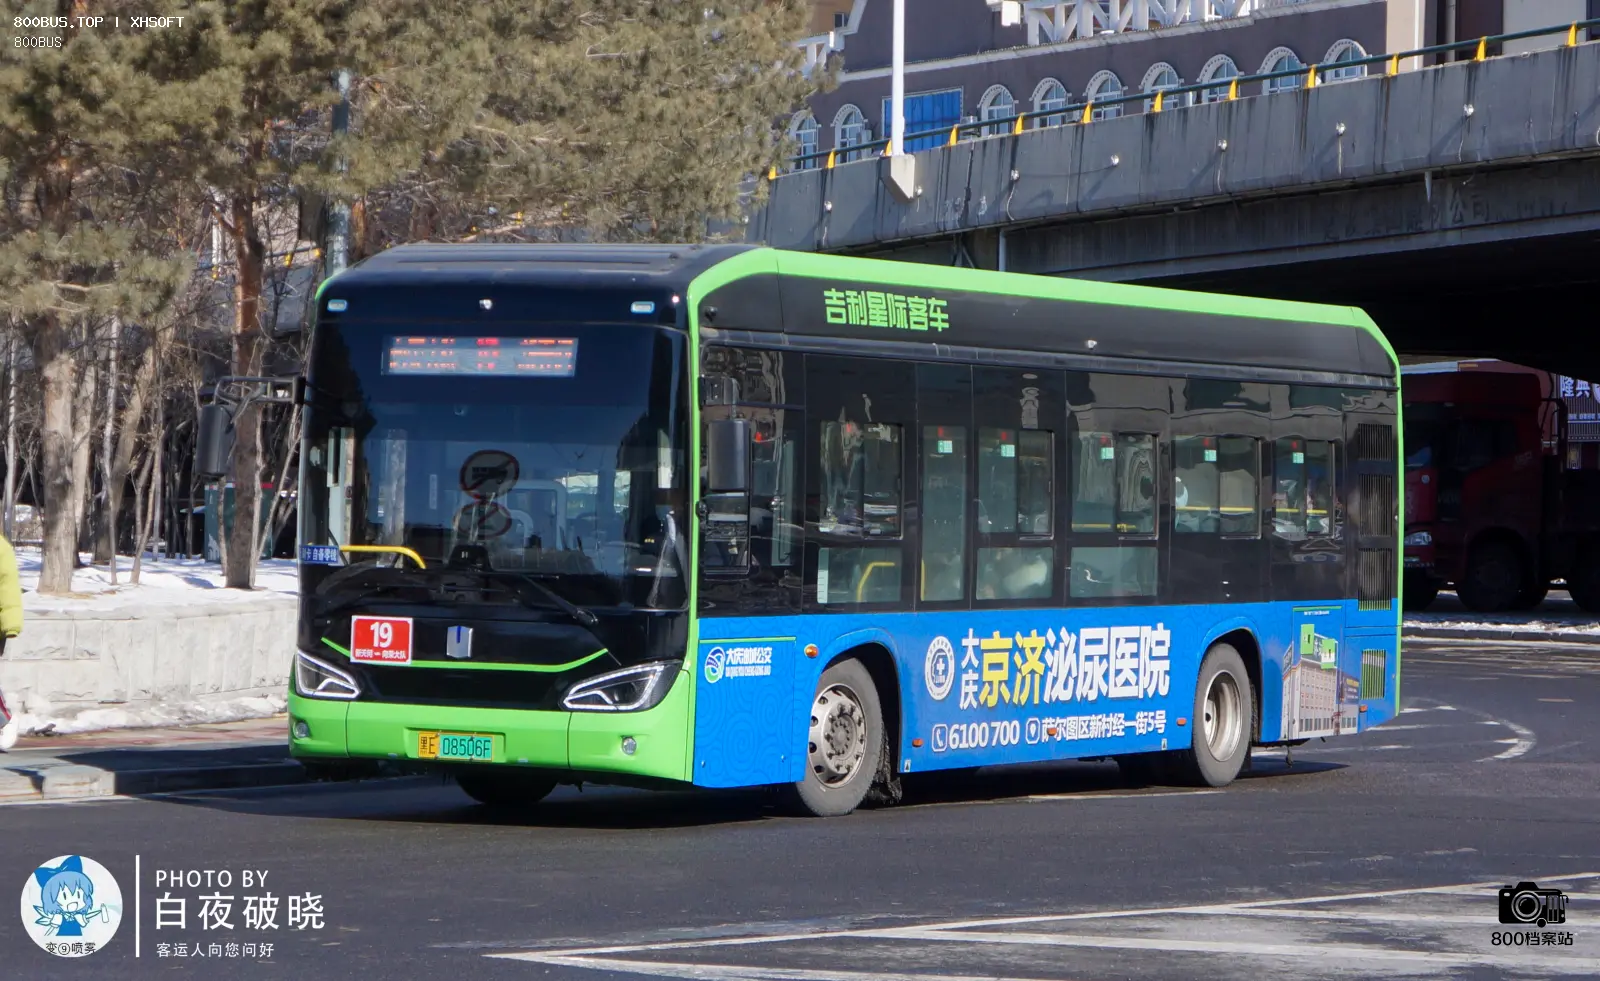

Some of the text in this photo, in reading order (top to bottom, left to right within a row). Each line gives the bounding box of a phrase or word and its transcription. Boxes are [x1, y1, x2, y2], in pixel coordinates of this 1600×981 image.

[824, 288, 949, 332] 吉利星际客车
[370, 621, 393, 648] 19
[979, 623, 1171, 707] 京济泌尿医院
[443, 737, 491, 758] 08506F
